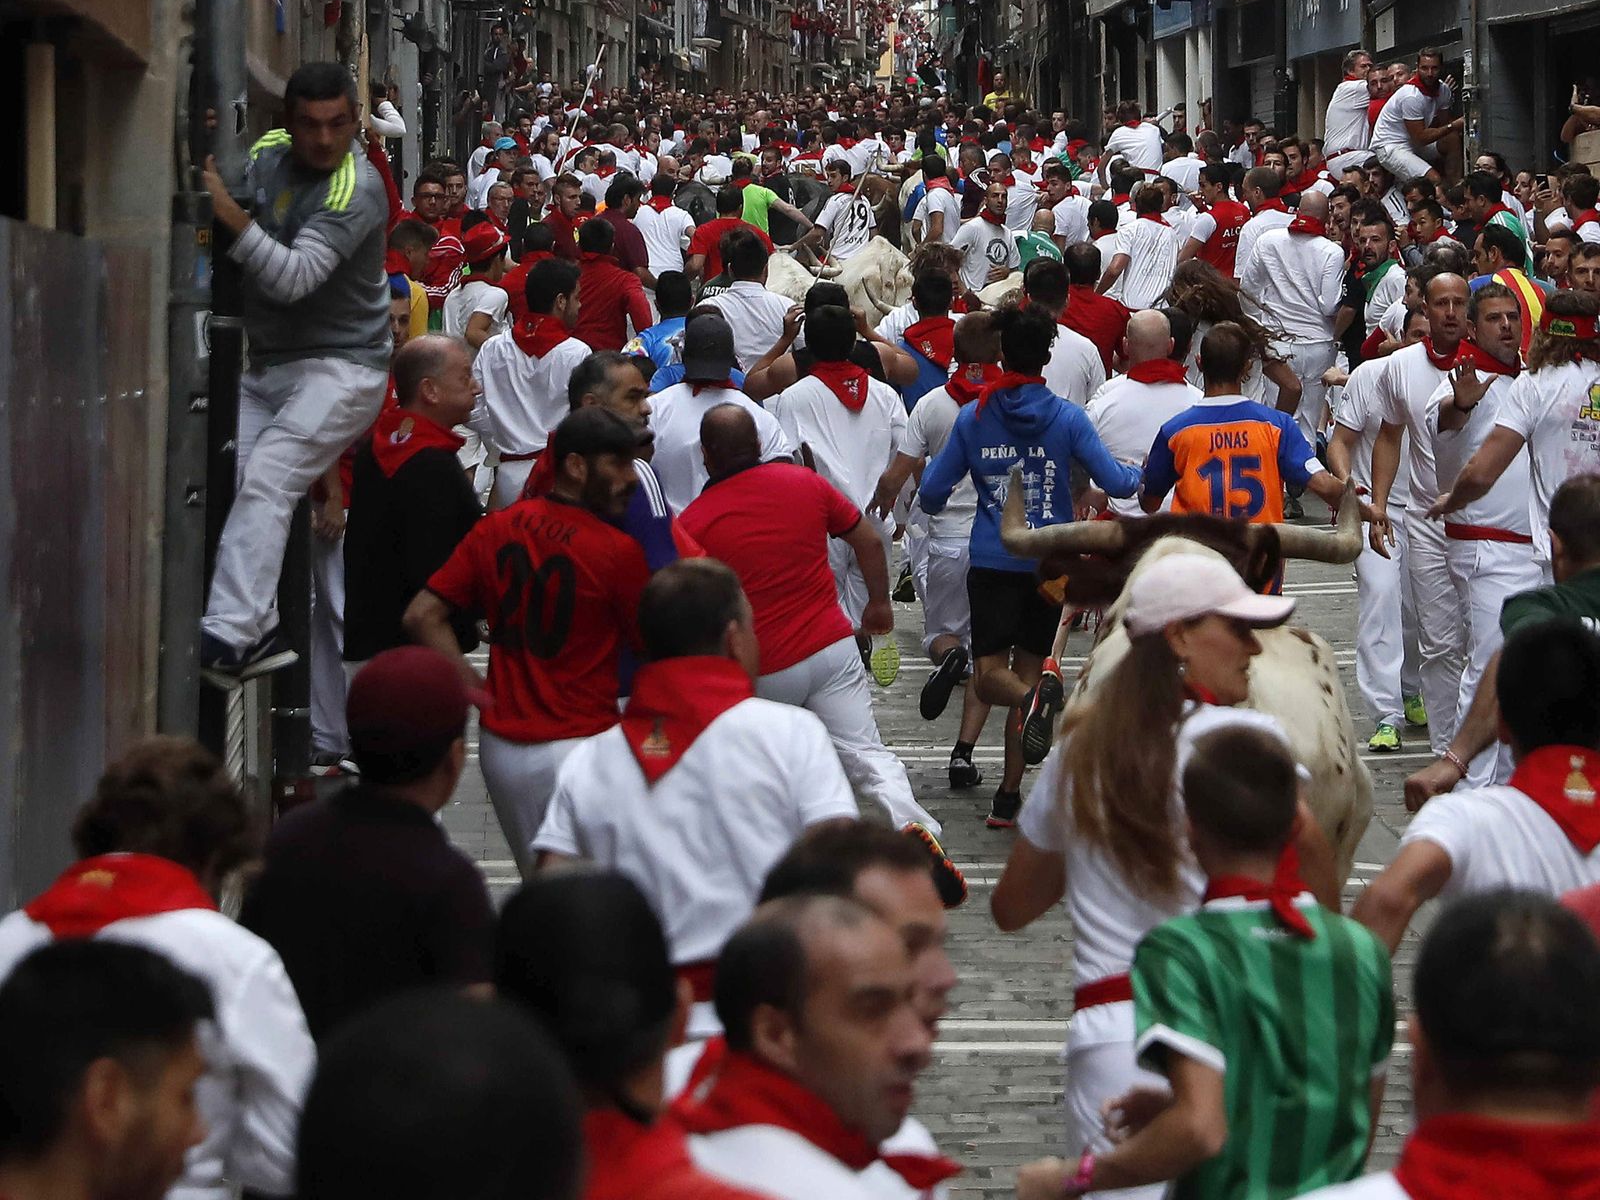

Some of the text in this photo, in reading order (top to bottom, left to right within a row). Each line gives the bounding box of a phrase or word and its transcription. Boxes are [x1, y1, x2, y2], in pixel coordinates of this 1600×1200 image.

[848, 202, 867, 233] 19
[981, 444, 1046, 459] PEÑA LA
[1196, 454, 1267, 518] 15
[492, 542, 577, 661] 20
